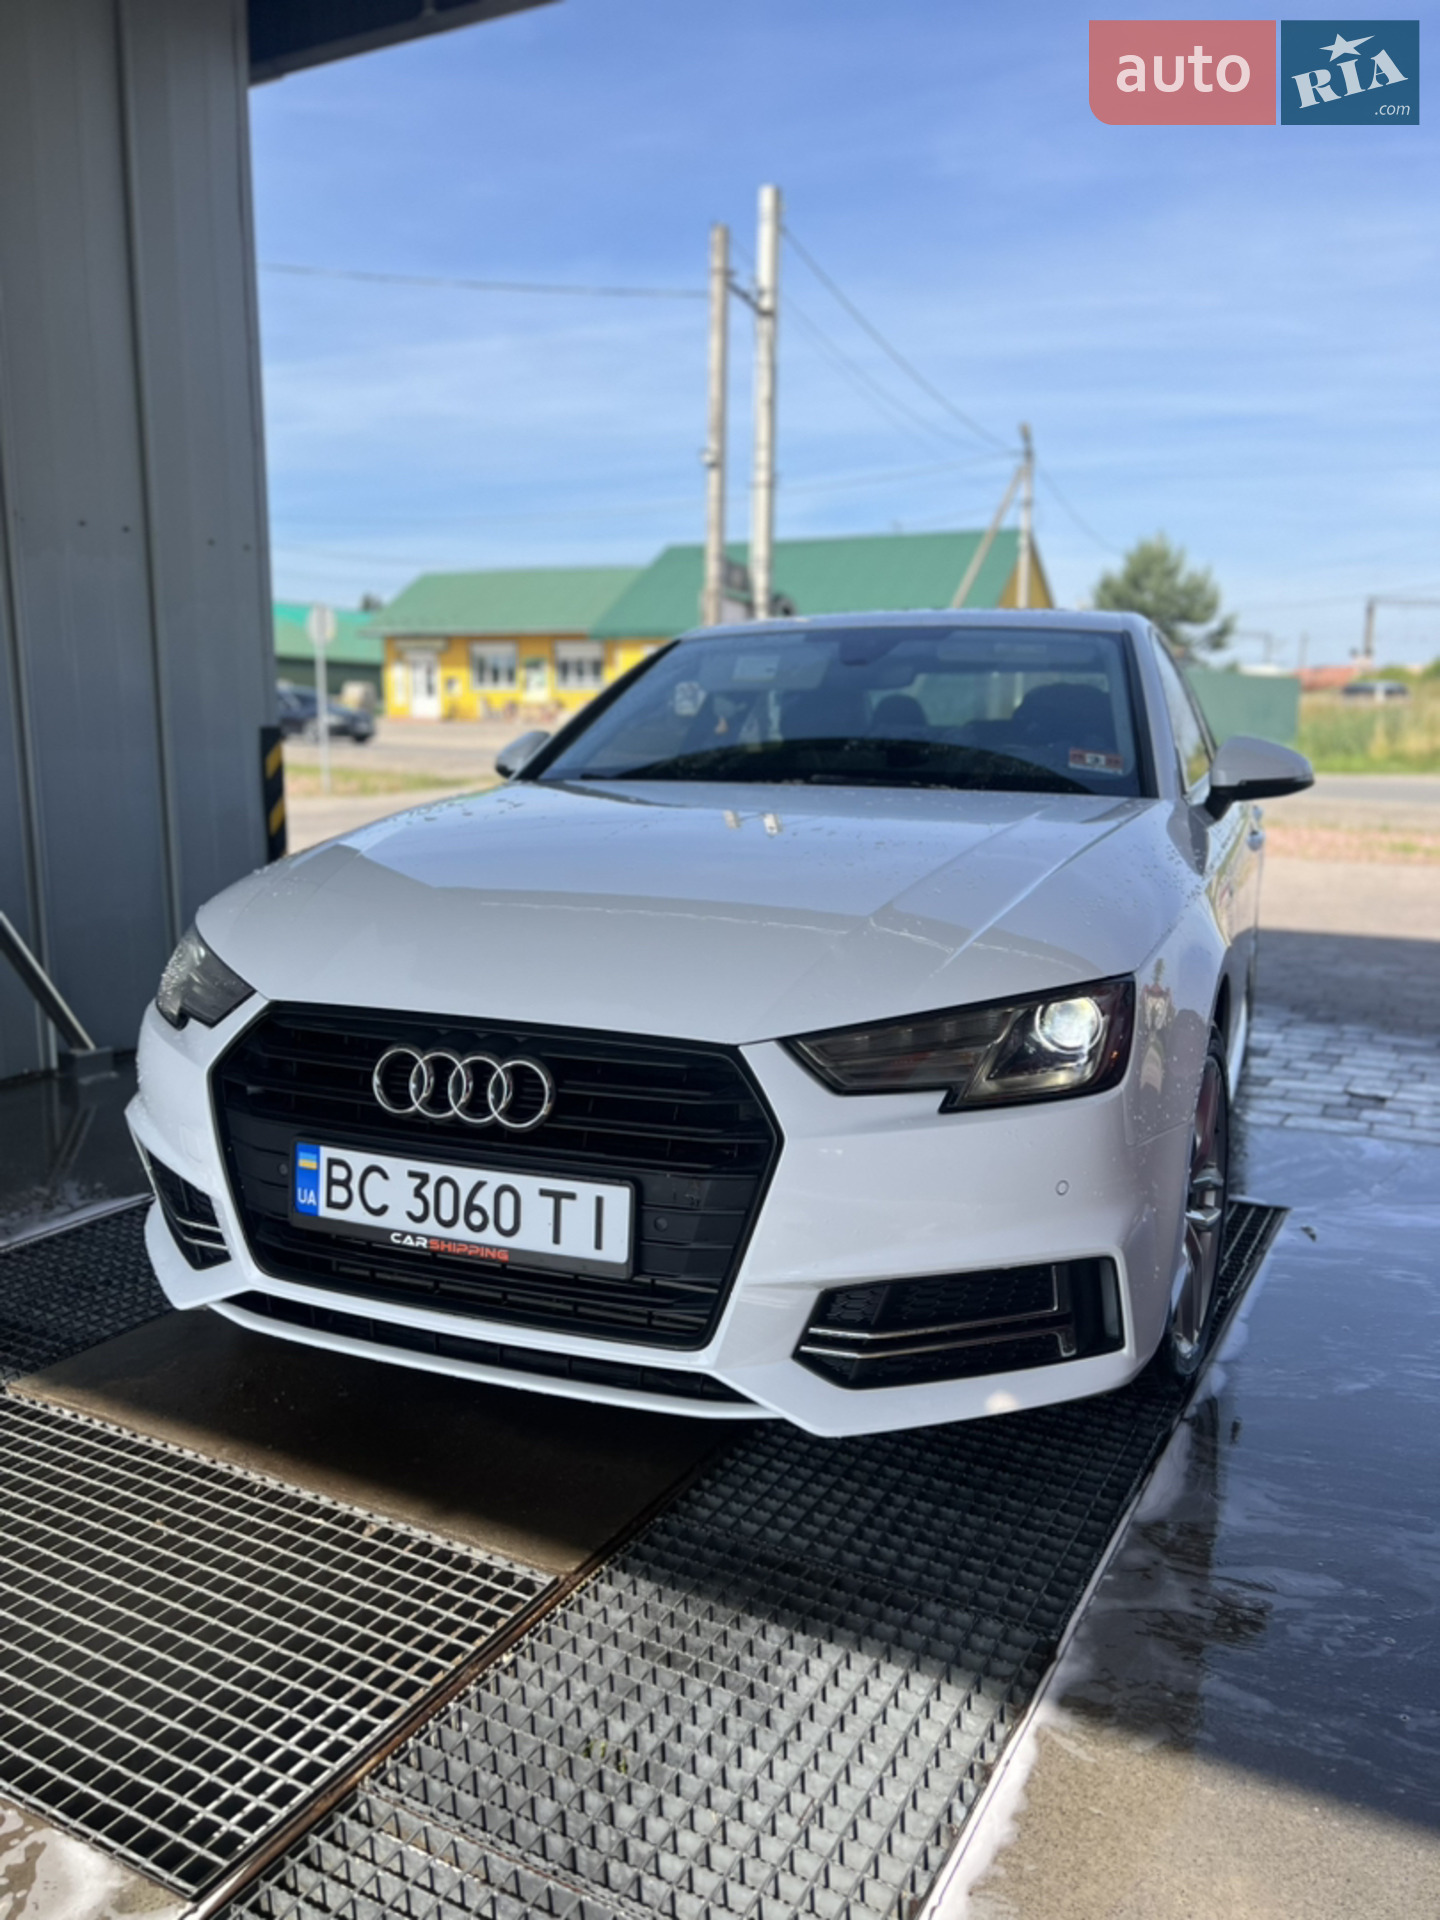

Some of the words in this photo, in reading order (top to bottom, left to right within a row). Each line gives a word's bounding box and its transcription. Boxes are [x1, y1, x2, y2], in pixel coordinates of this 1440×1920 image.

[297, 1186, 317, 1207] UA
[326, 1157, 390, 1217] BC
[405, 1170, 522, 1238] 3060
[538, 1188, 604, 1251] TI
